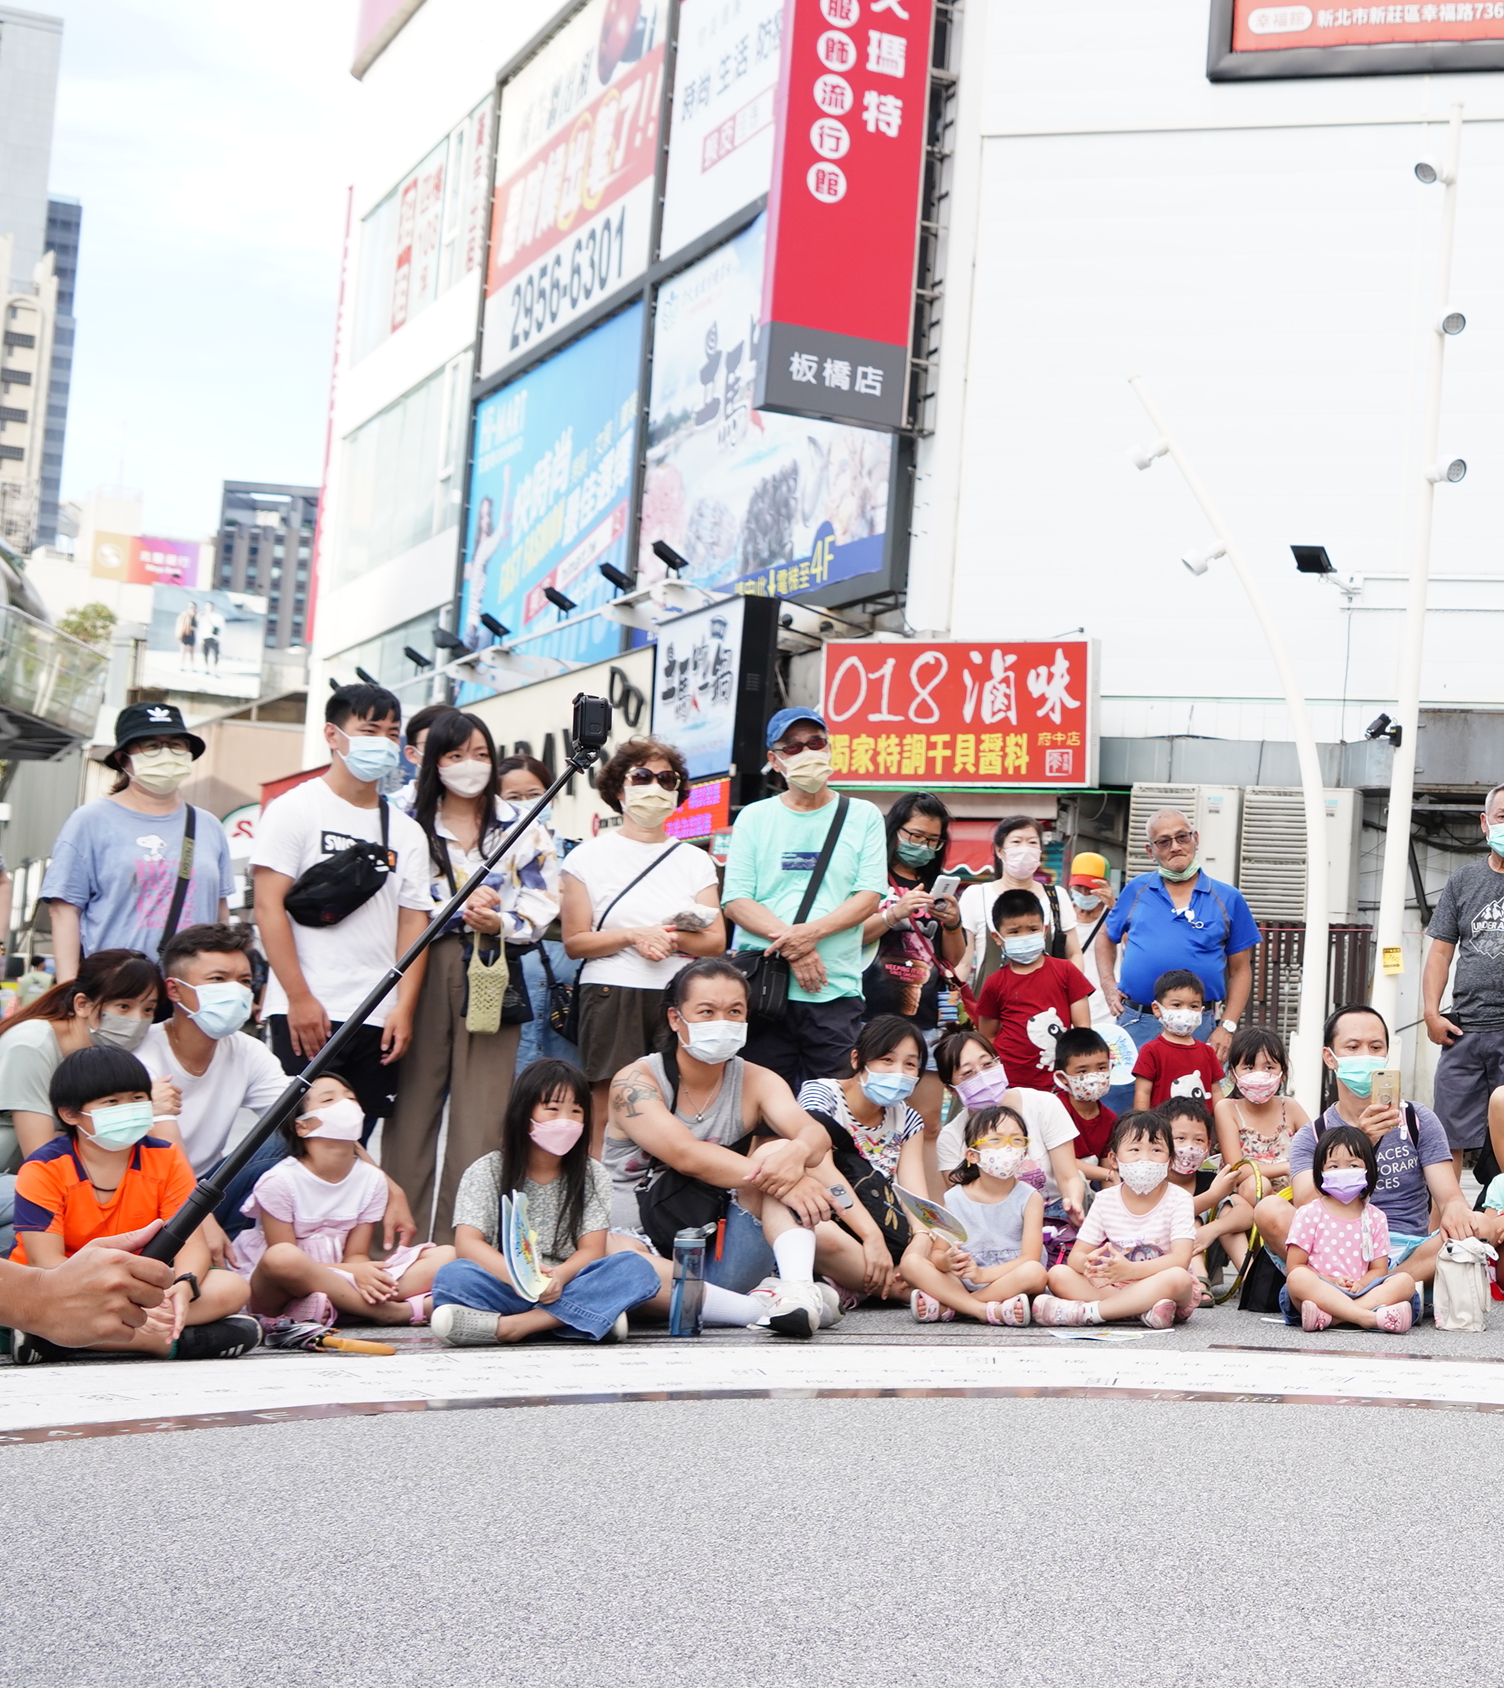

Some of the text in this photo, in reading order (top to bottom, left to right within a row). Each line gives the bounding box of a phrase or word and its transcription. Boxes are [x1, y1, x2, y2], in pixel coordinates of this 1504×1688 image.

[509, 204, 626, 352] 2956-6301
[790, 351, 884, 397] 板橋店
[1037, 731, 1081, 746] 府中店
[1473, 921, 1497, 931] UNDER
[1377, 1156, 1419, 1175] ORARY
